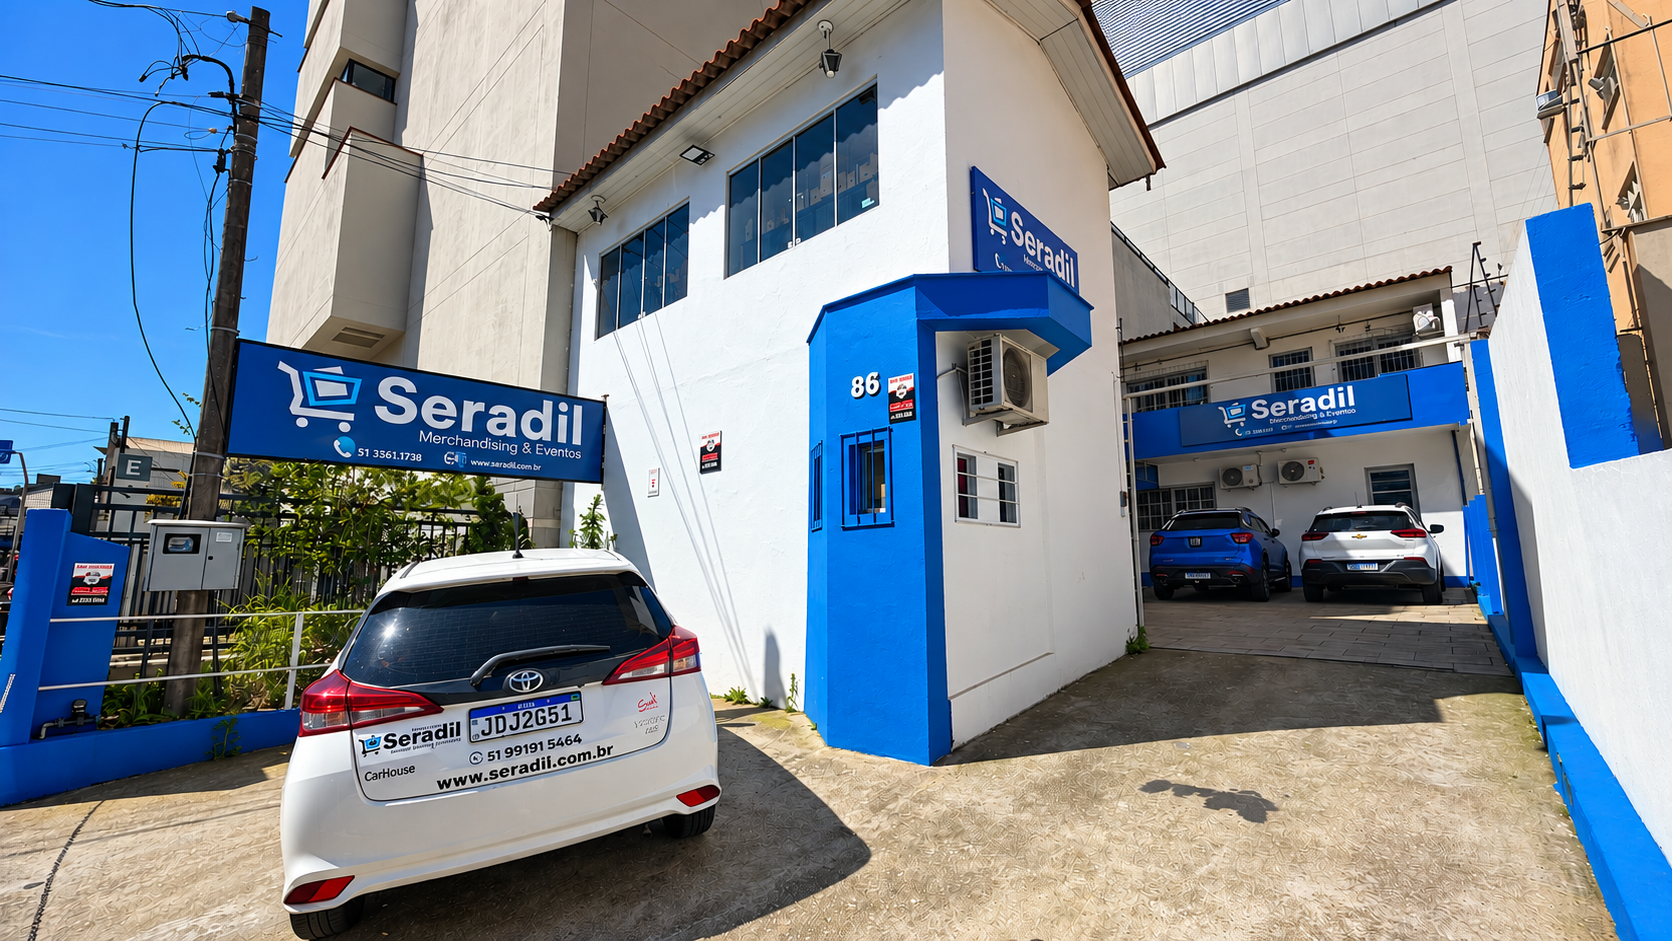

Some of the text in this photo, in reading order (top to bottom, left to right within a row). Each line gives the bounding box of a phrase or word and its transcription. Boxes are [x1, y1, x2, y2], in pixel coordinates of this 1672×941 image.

[1011, 211, 1075, 288] Seradil
[851, 372, 880, 398] 86
[374, 376, 583, 446] Seradil
[1251, 385, 1355, 419] Seradil
[419, 430, 582, 459] Merchandising & Eventos
[126, 459, 142, 476] E
[481, 703, 572, 736] JDJ2G51
[383, 721, 461, 749] Seradil
[487, 734, 582, 761] 51 99191 5464
[364, 765, 416, 782] CarHouse
[437, 745, 613, 790] www.seradil.com.br
